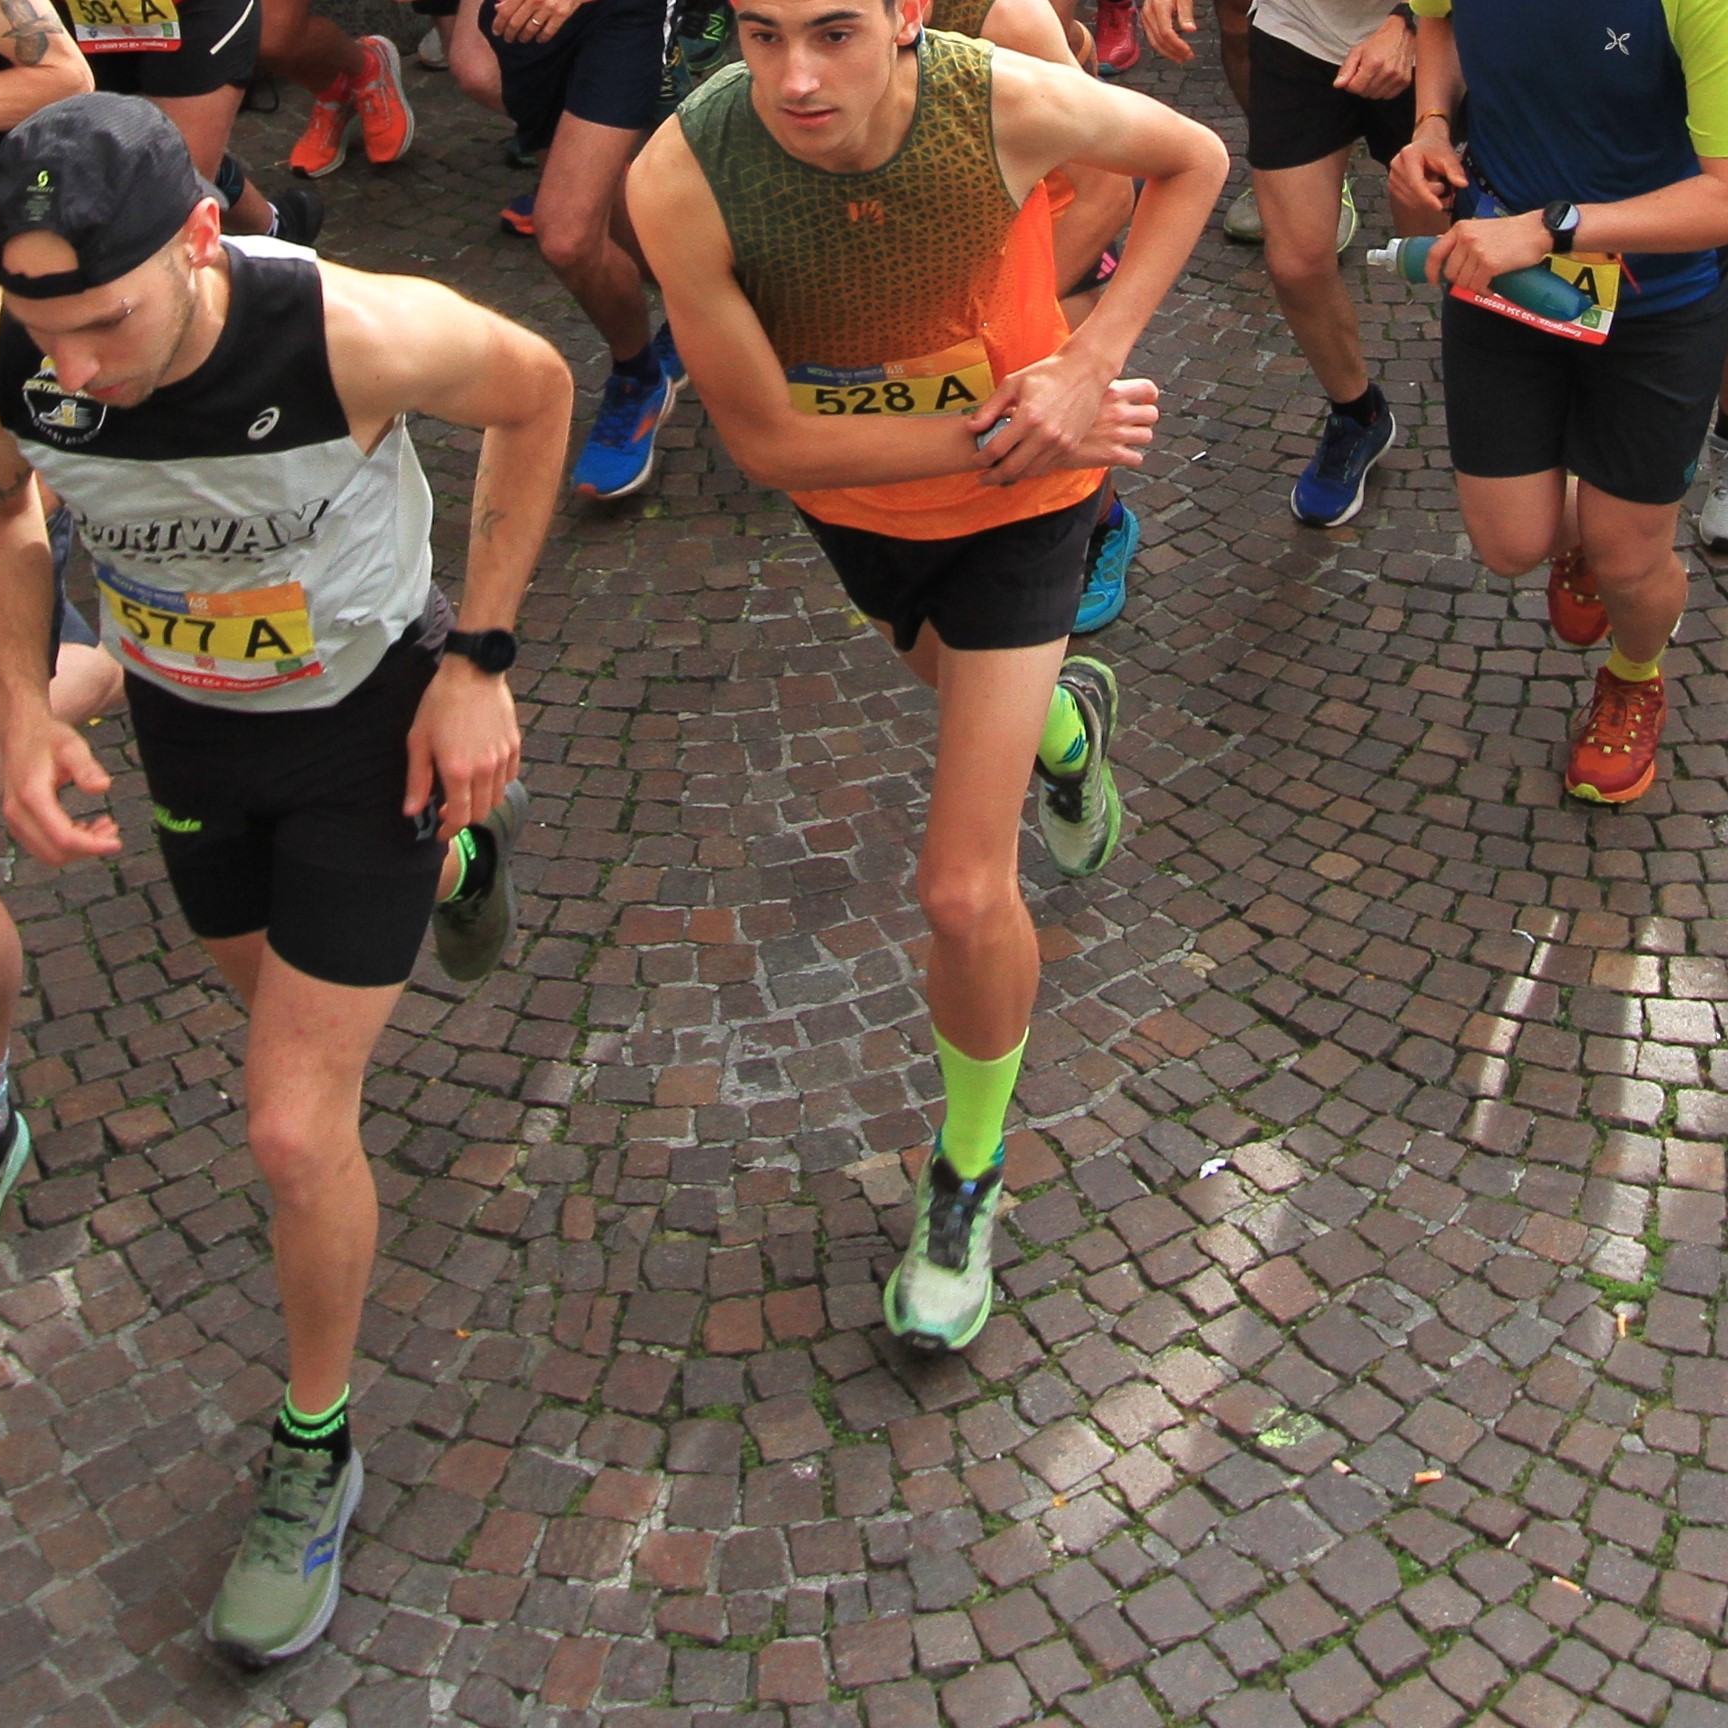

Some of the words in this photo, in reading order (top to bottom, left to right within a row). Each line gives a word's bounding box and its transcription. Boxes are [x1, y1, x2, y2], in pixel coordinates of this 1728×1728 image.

[1574, 265, 1601, 307] A
[814, 380, 916, 416] 528
[934, 374, 979, 411] A
[120, 600, 218, 654] 577
[244, 617, 293, 659] A
